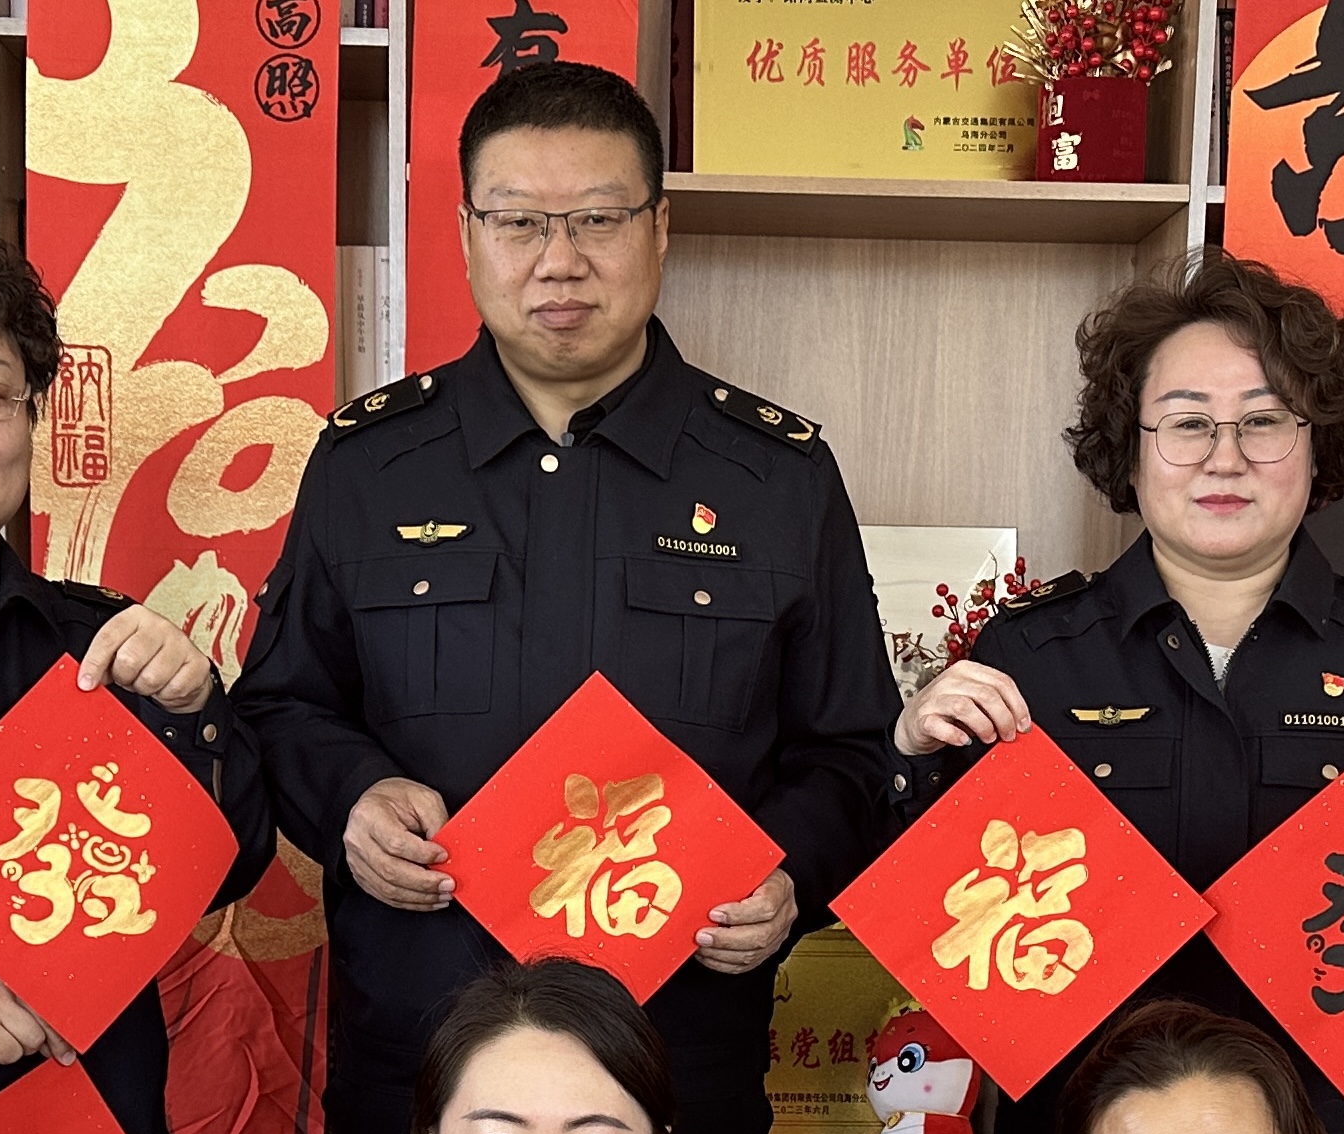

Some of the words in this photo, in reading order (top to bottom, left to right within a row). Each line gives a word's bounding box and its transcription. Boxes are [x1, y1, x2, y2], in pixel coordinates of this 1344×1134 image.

[746, 37, 1030, 91] 优质服务单位
[657, 536, 738, 556] 01101001001
[529, 773, 683, 939] 福
[931, 819, 1095, 995] 福
